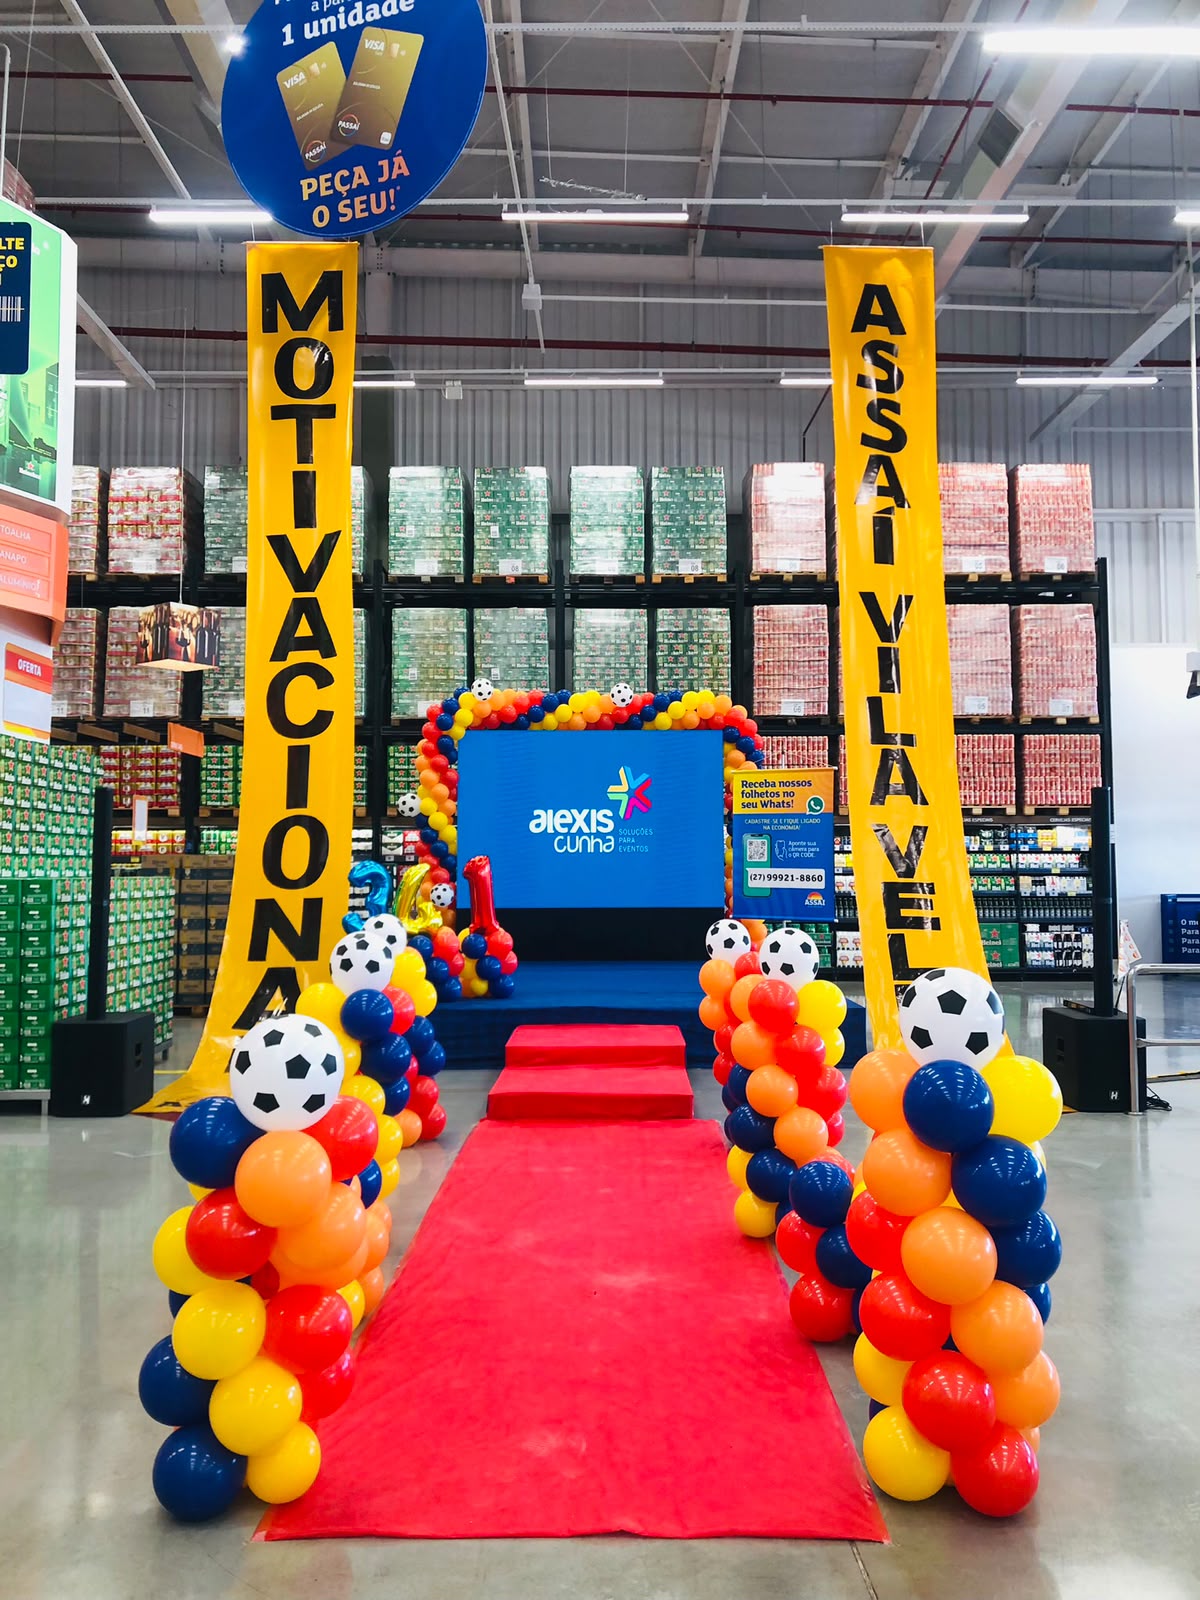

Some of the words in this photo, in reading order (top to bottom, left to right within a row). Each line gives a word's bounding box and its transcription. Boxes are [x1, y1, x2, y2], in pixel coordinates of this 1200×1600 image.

[282, 23, 294, 46] 1
[304, 0, 415, 40] unidade
[364, 39, 385, 52] VISA
[283, 72, 306, 89] VISA
[300, 165, 370, 200] PEÇA
[378, 149, 410, 183] JÁ
[312, 205, 330, 228] O
[850, 283, 912, 566] ASSAÍ
[0, 524, 31, 541] TOALHA
[17, 658, 42, 677] OFERTA
[224, 270, 344, 1073] MOTIVACIONA
[859, 591, 929, 806] VILA
[741, 779, 777, 789] Receba
[778, 780, 812, 788] nossos
[741, 789, 780, 799] folhetos
[783, 790, 795, 798] no
[741, 800, 758, 809] seu
[760, 799, 794, 809] Whats!
[618, 827, 654, 837] SOLUÇÕES
[618, 845, 649, 853] EVENTOS
[749, 873, 766, 882] (27)
[766, 873, 824, 882] 99921-8860
[871, 824, 942, 1008] VEL
